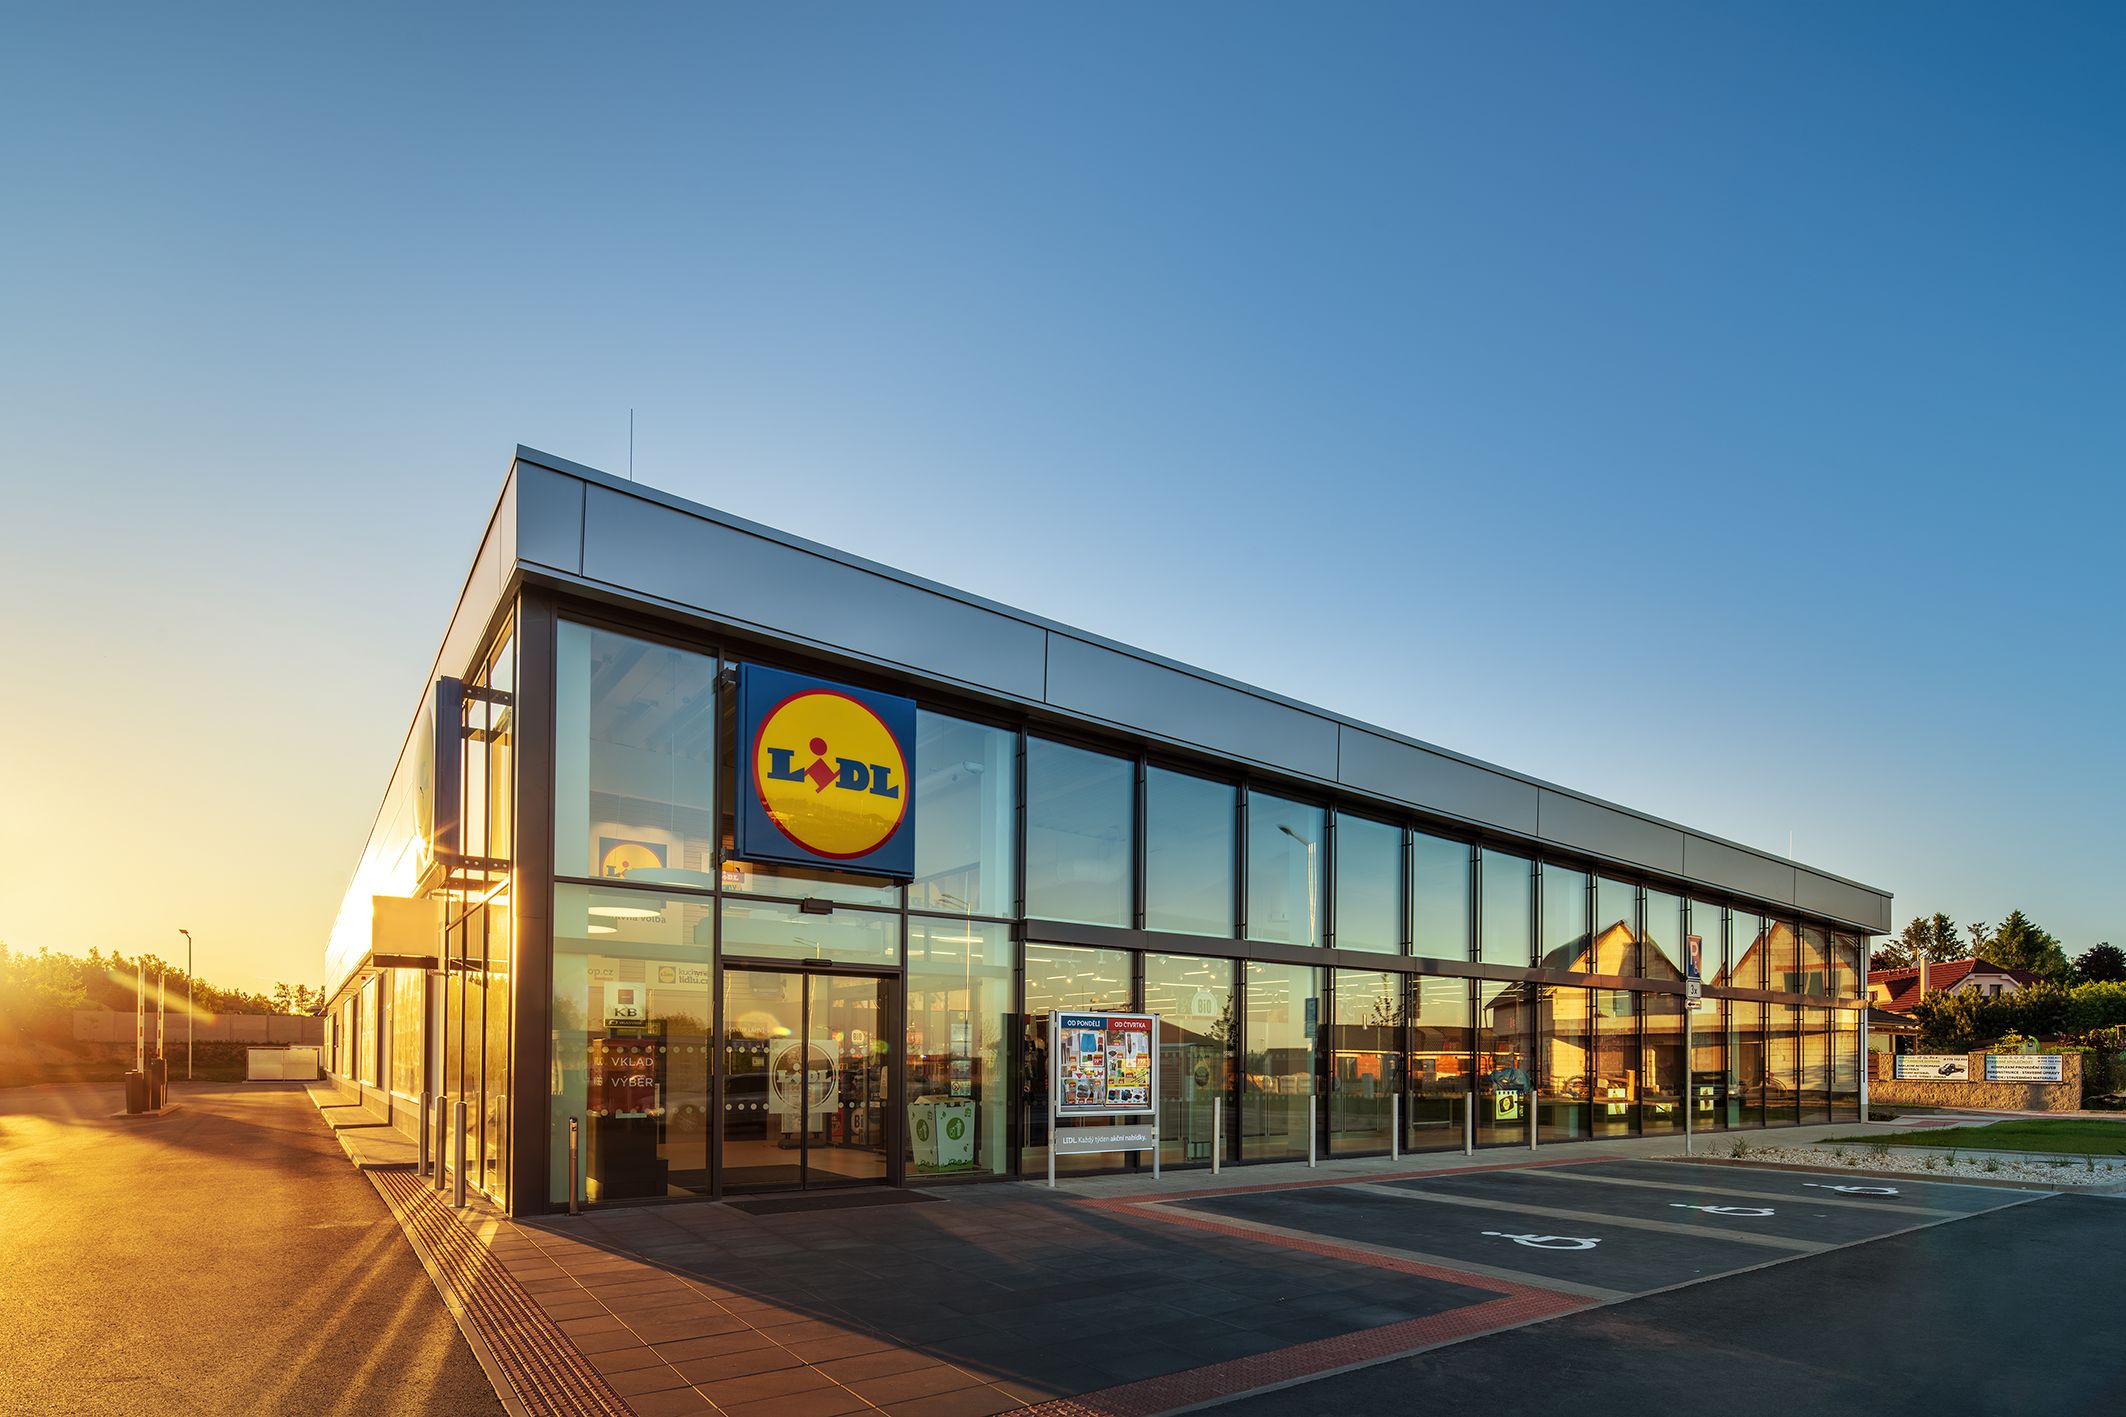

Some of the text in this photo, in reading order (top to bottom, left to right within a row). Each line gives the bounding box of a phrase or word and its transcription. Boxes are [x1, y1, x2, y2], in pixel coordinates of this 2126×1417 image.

[1690, 941, 1698, 965] P
[1690, 984, 1698, 995] 3x
[614, 1008, 638, 1017] KB
[611, 1057, 654, 1067] VKLAD
